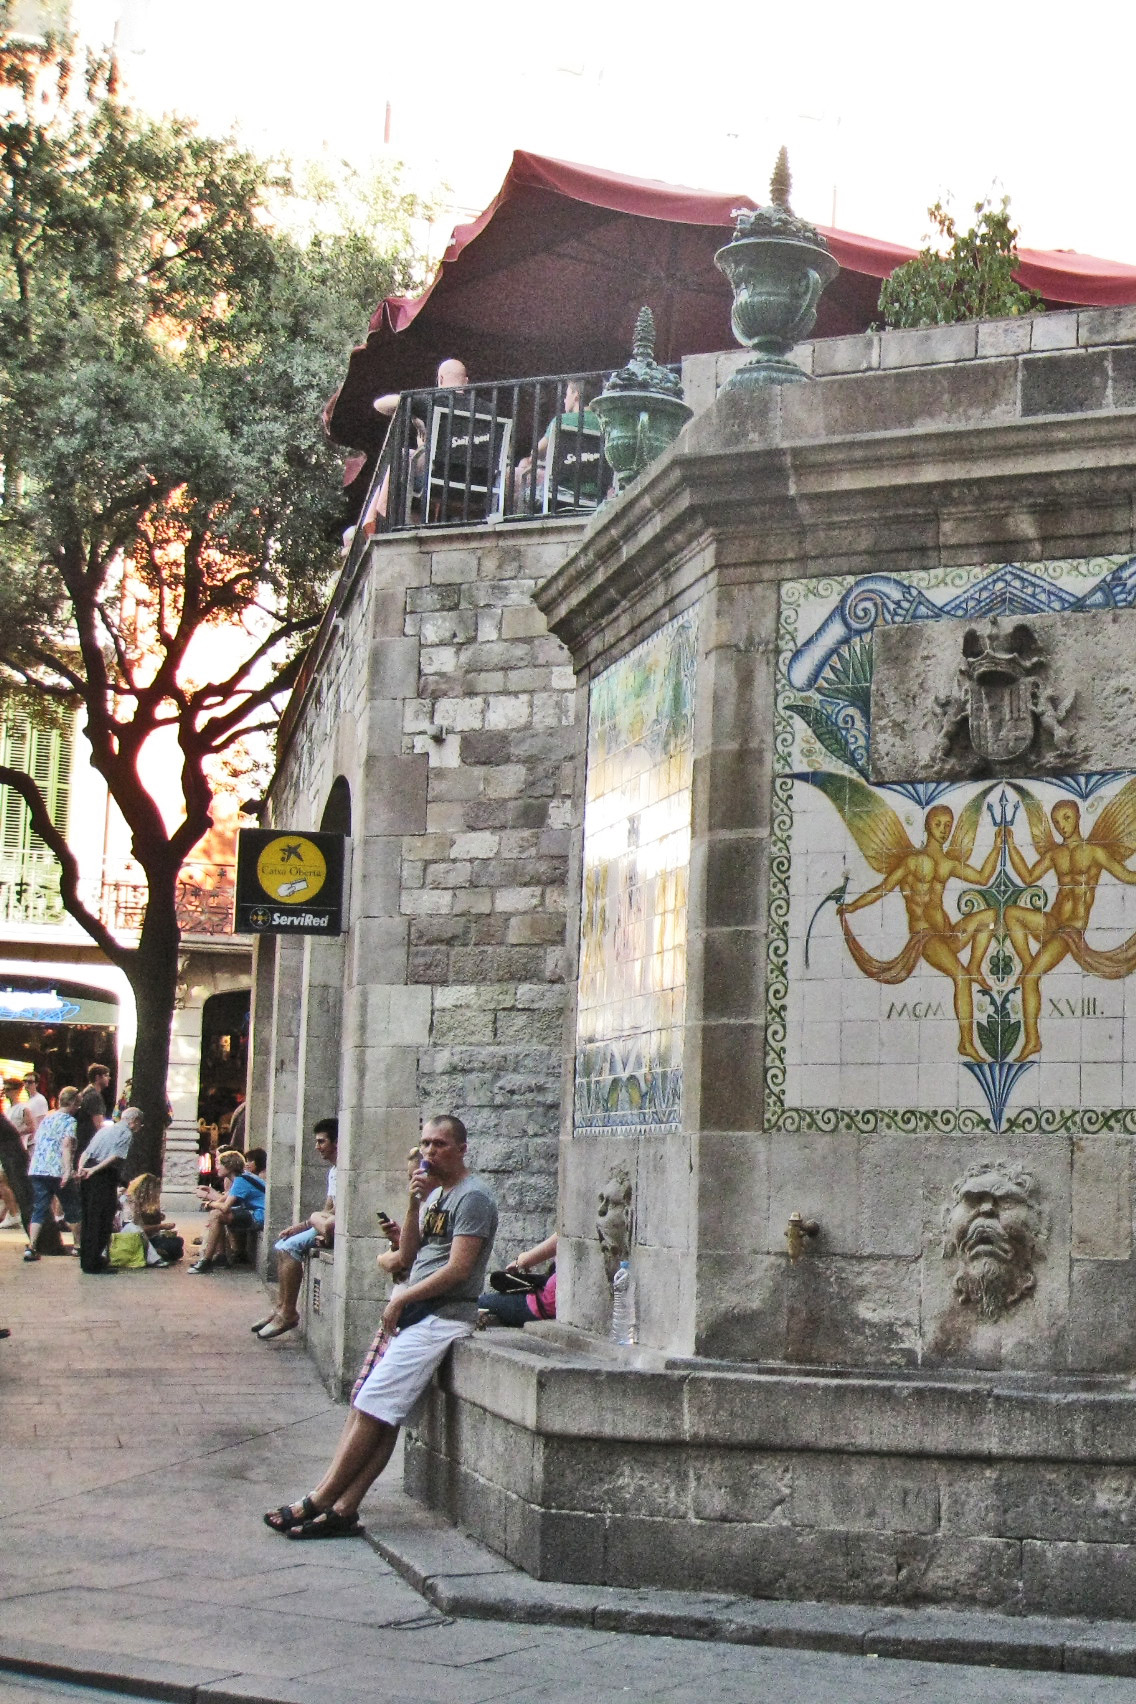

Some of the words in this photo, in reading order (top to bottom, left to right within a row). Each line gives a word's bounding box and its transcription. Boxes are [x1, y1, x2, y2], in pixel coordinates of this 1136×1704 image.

[261, 866, 287, 876] Caixa
[289, 867, 322, 877] Oberta
[271, 912, 330, 928] ServiRed
[886, 1001, 945, 1019] MCM
